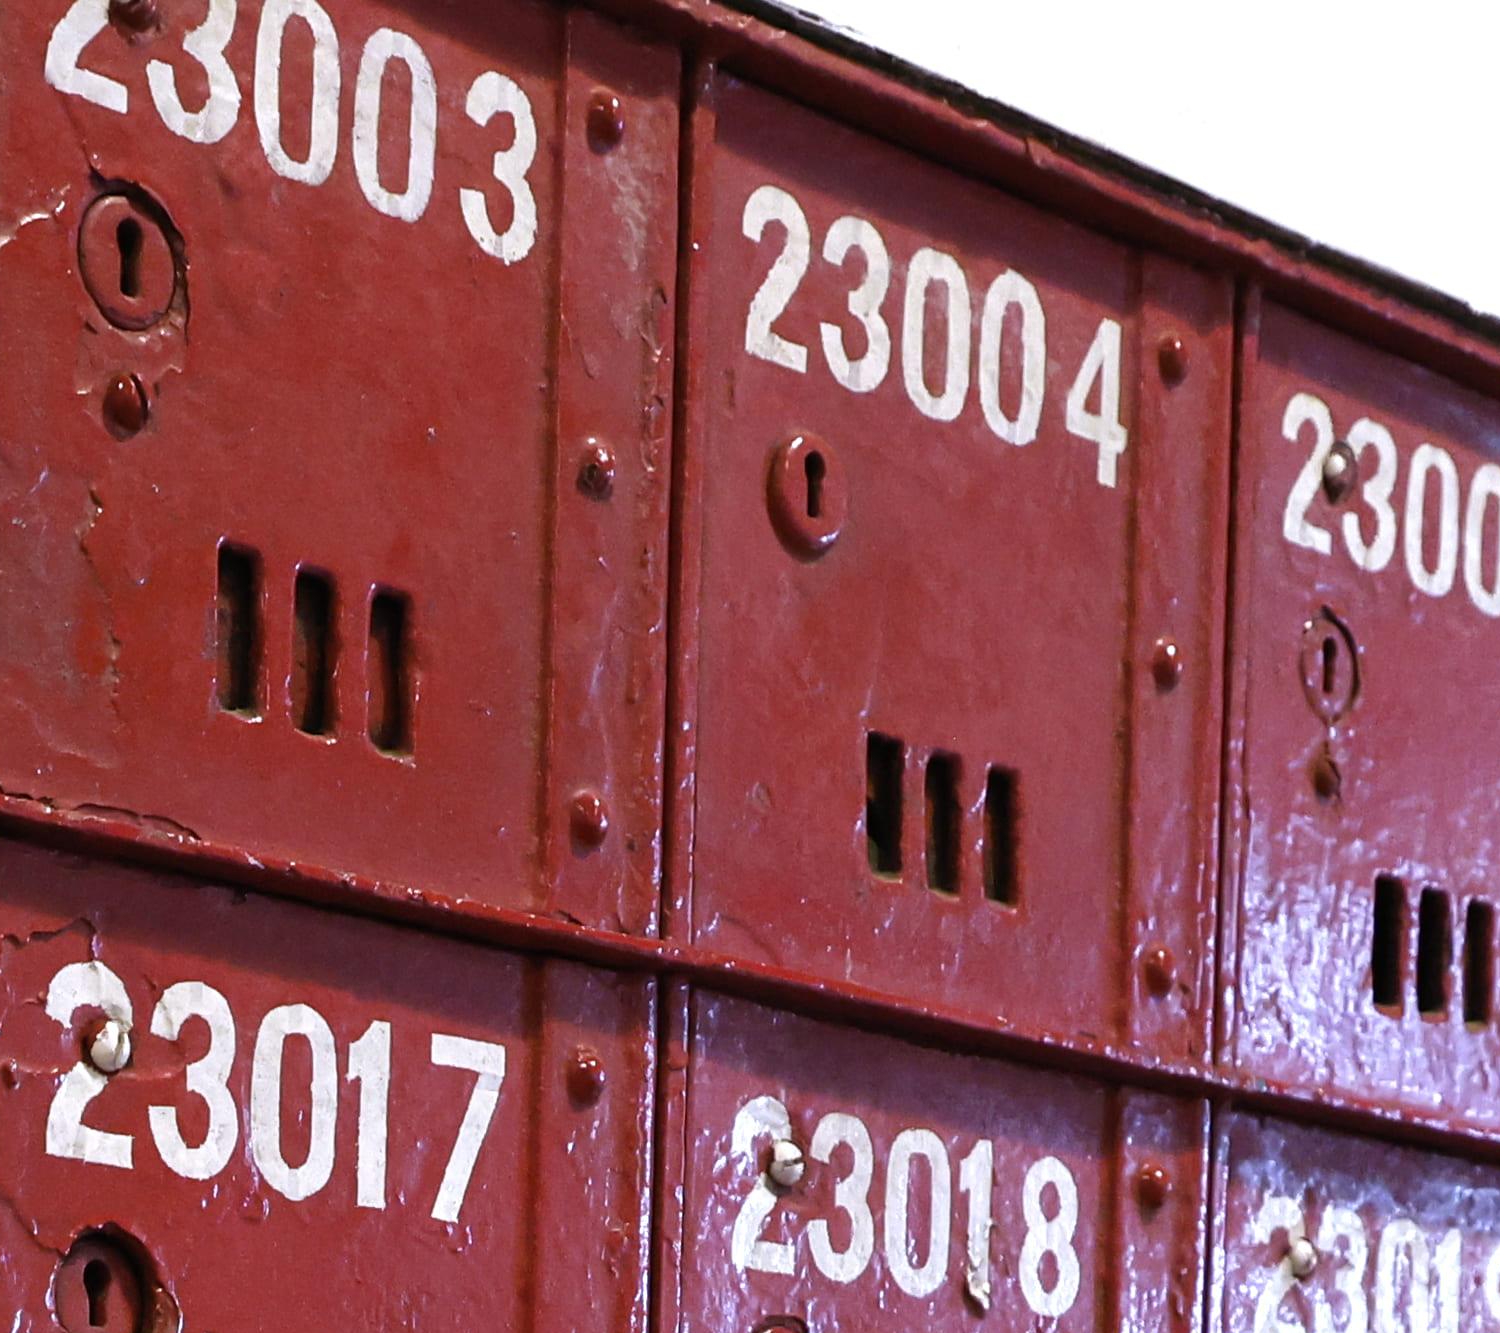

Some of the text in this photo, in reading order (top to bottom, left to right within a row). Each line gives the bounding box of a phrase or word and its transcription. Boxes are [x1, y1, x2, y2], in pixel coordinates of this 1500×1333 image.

[45, 0, 537, 265] 23003
[743, 186, 1127, 487] 23004
[46, 961, 505, 1223] 23017
[730, 1096, 1080, 1322] 23018
